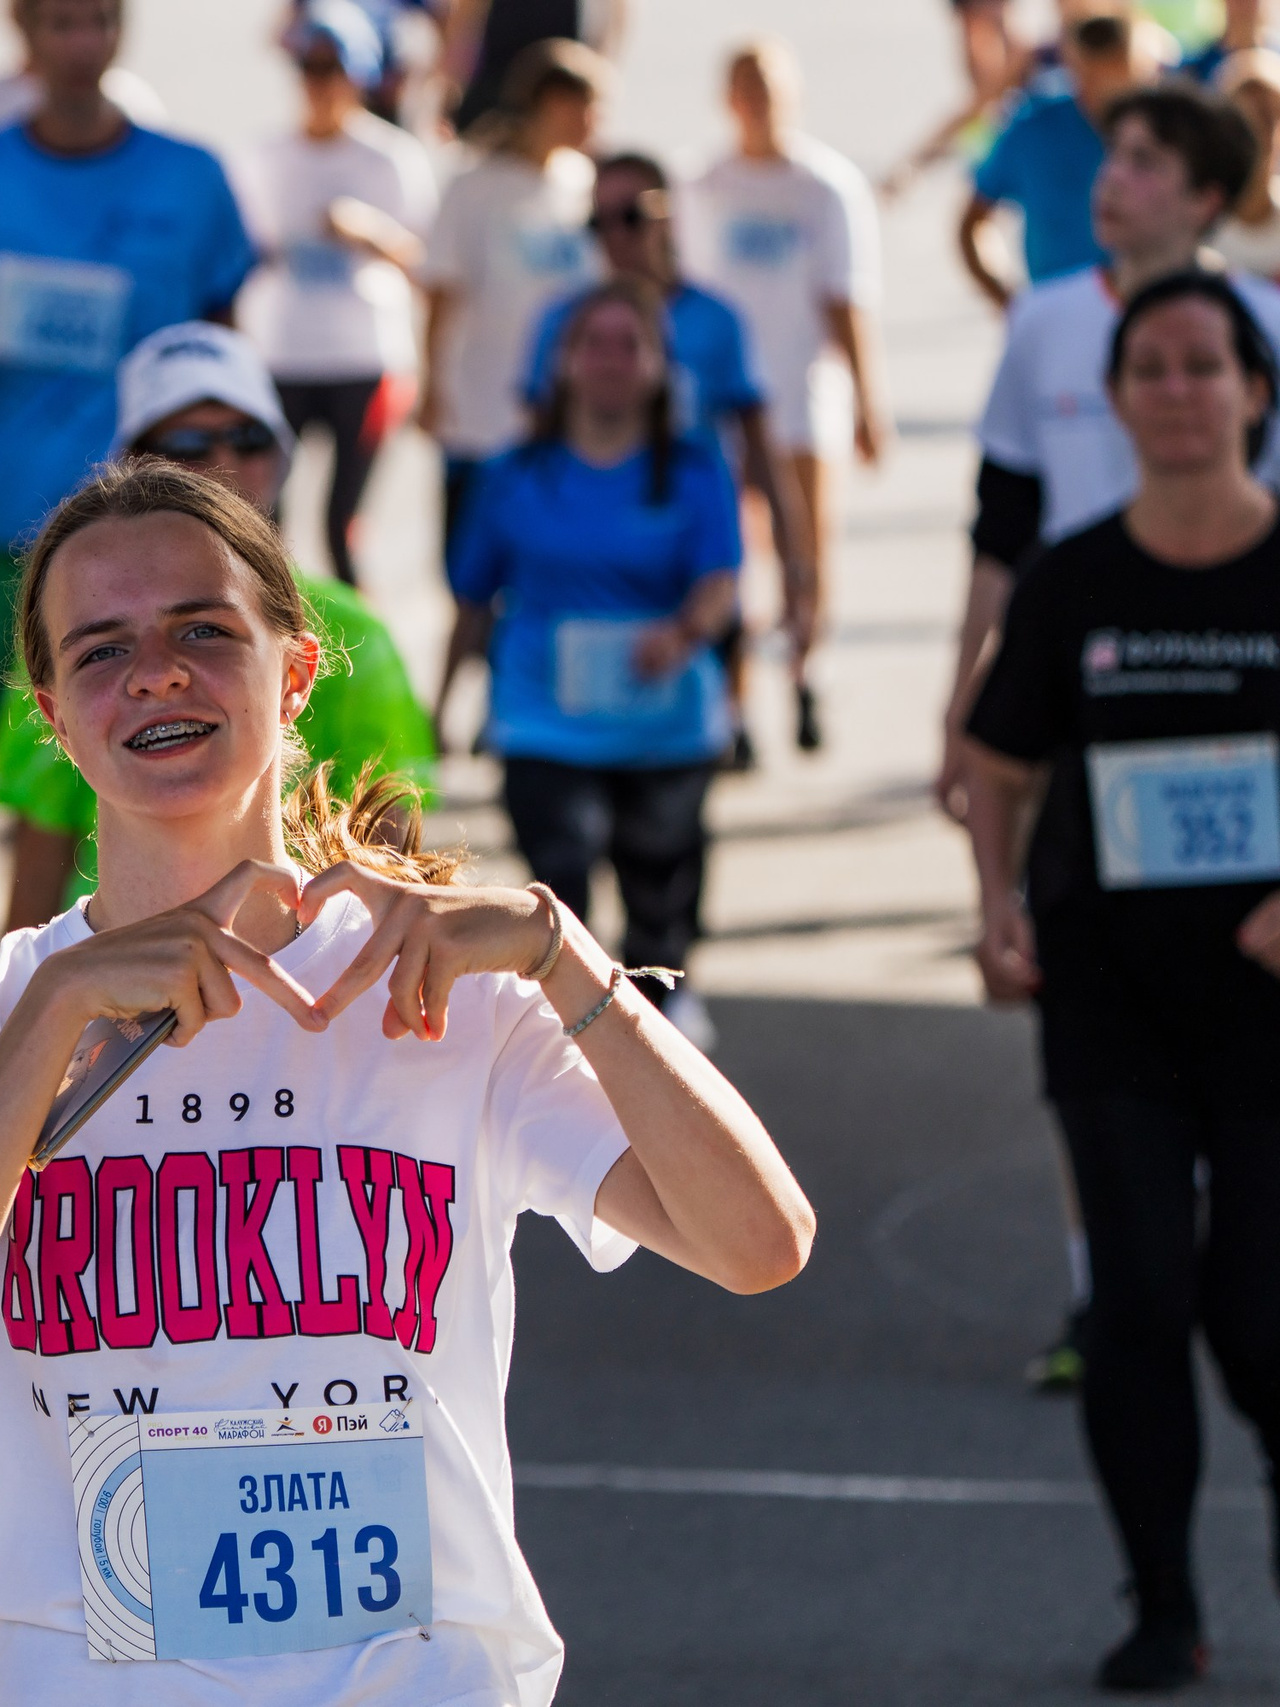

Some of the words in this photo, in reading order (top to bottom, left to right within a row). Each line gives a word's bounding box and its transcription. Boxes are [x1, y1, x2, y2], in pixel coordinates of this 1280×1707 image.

[135, 1088, 295, 1124] 1898
[1, 1144, 456, 1357] BROOKLYN
[270, 1374, 438, 1409] YOR
[148, 1427, 190, 1438] СПОРТ
[192, 1426, 208, 1436] 40
[218, 1429, 265, 1440] МАРАФОН
[337, 1415, 368, 1432] Пэй
[238, 1470, 350, 1515] ЗЛАТА
[198, 1524, 402, 1624] 4313
